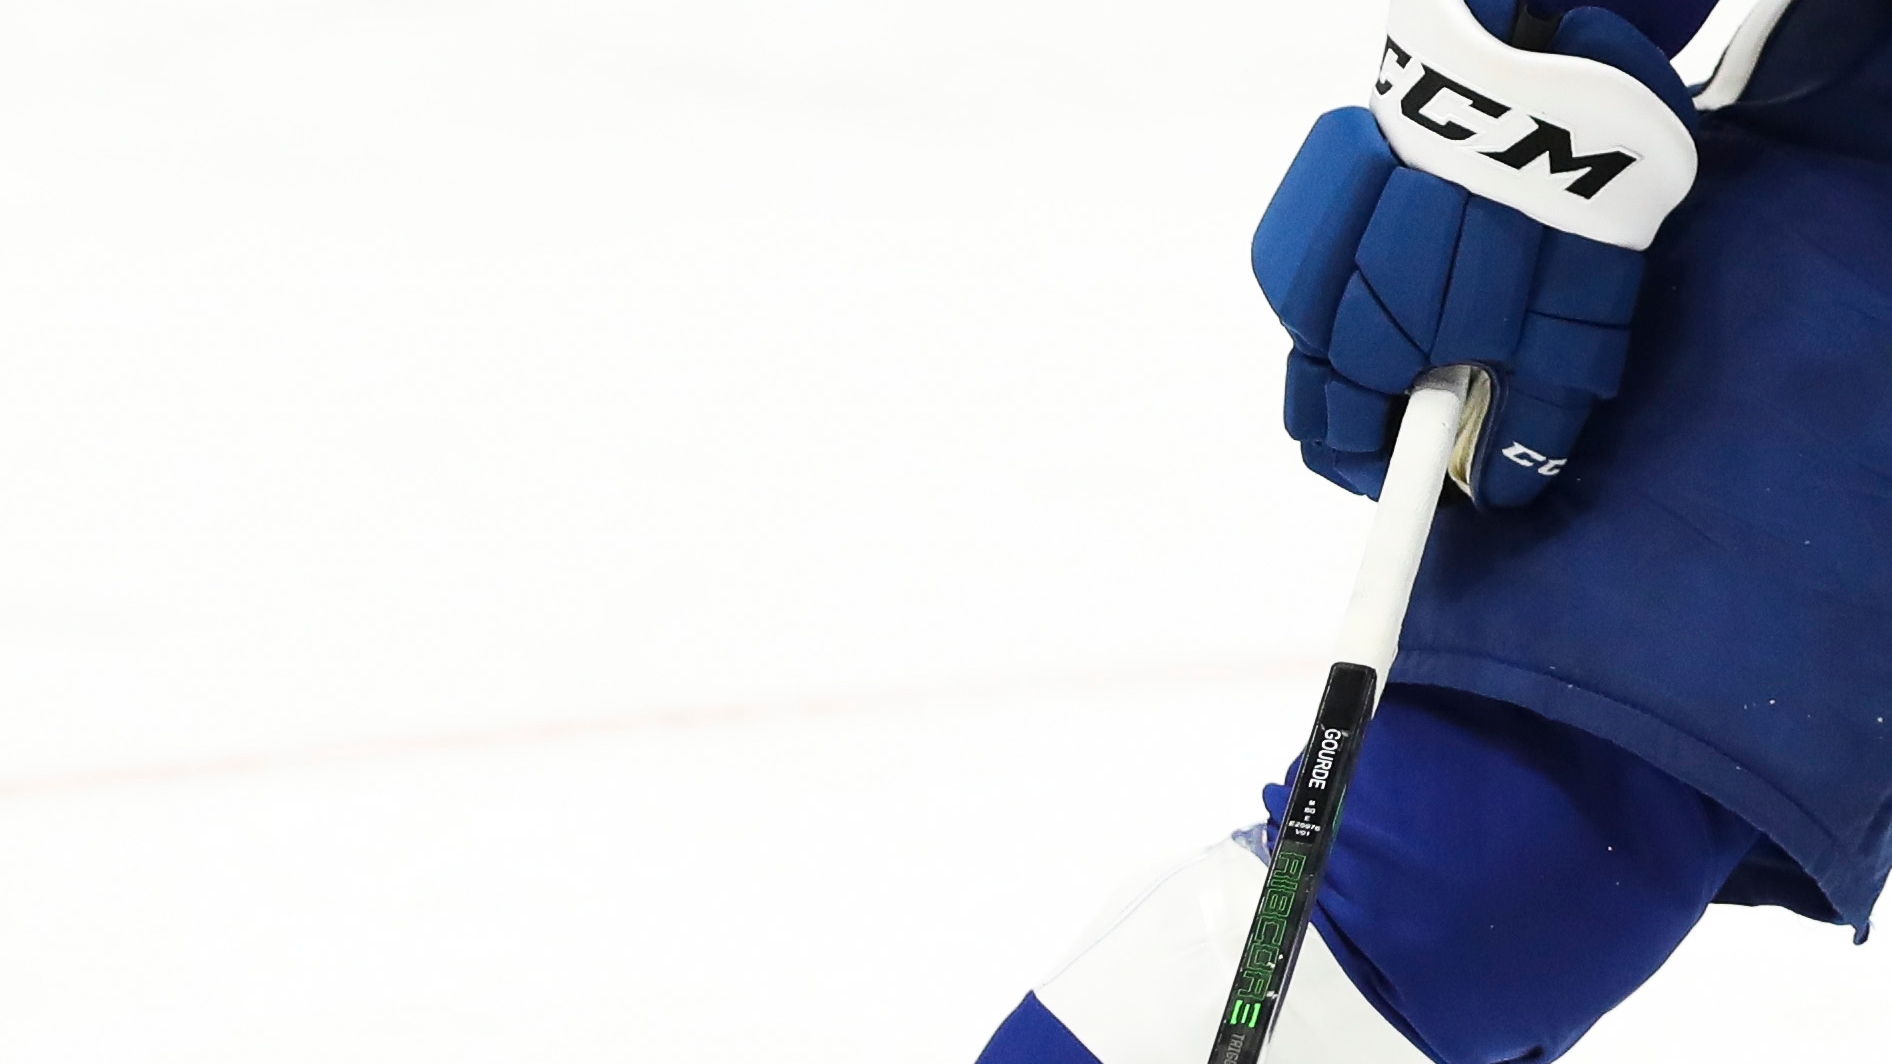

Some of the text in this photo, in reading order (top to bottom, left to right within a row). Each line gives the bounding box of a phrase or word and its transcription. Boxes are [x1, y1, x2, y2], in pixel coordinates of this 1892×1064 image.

[1374, 34, 1638, 201] CCM
[1308, 728, 1342, 790] GOURDE
[1229, 851, 1307, 1028] RIBCORE
